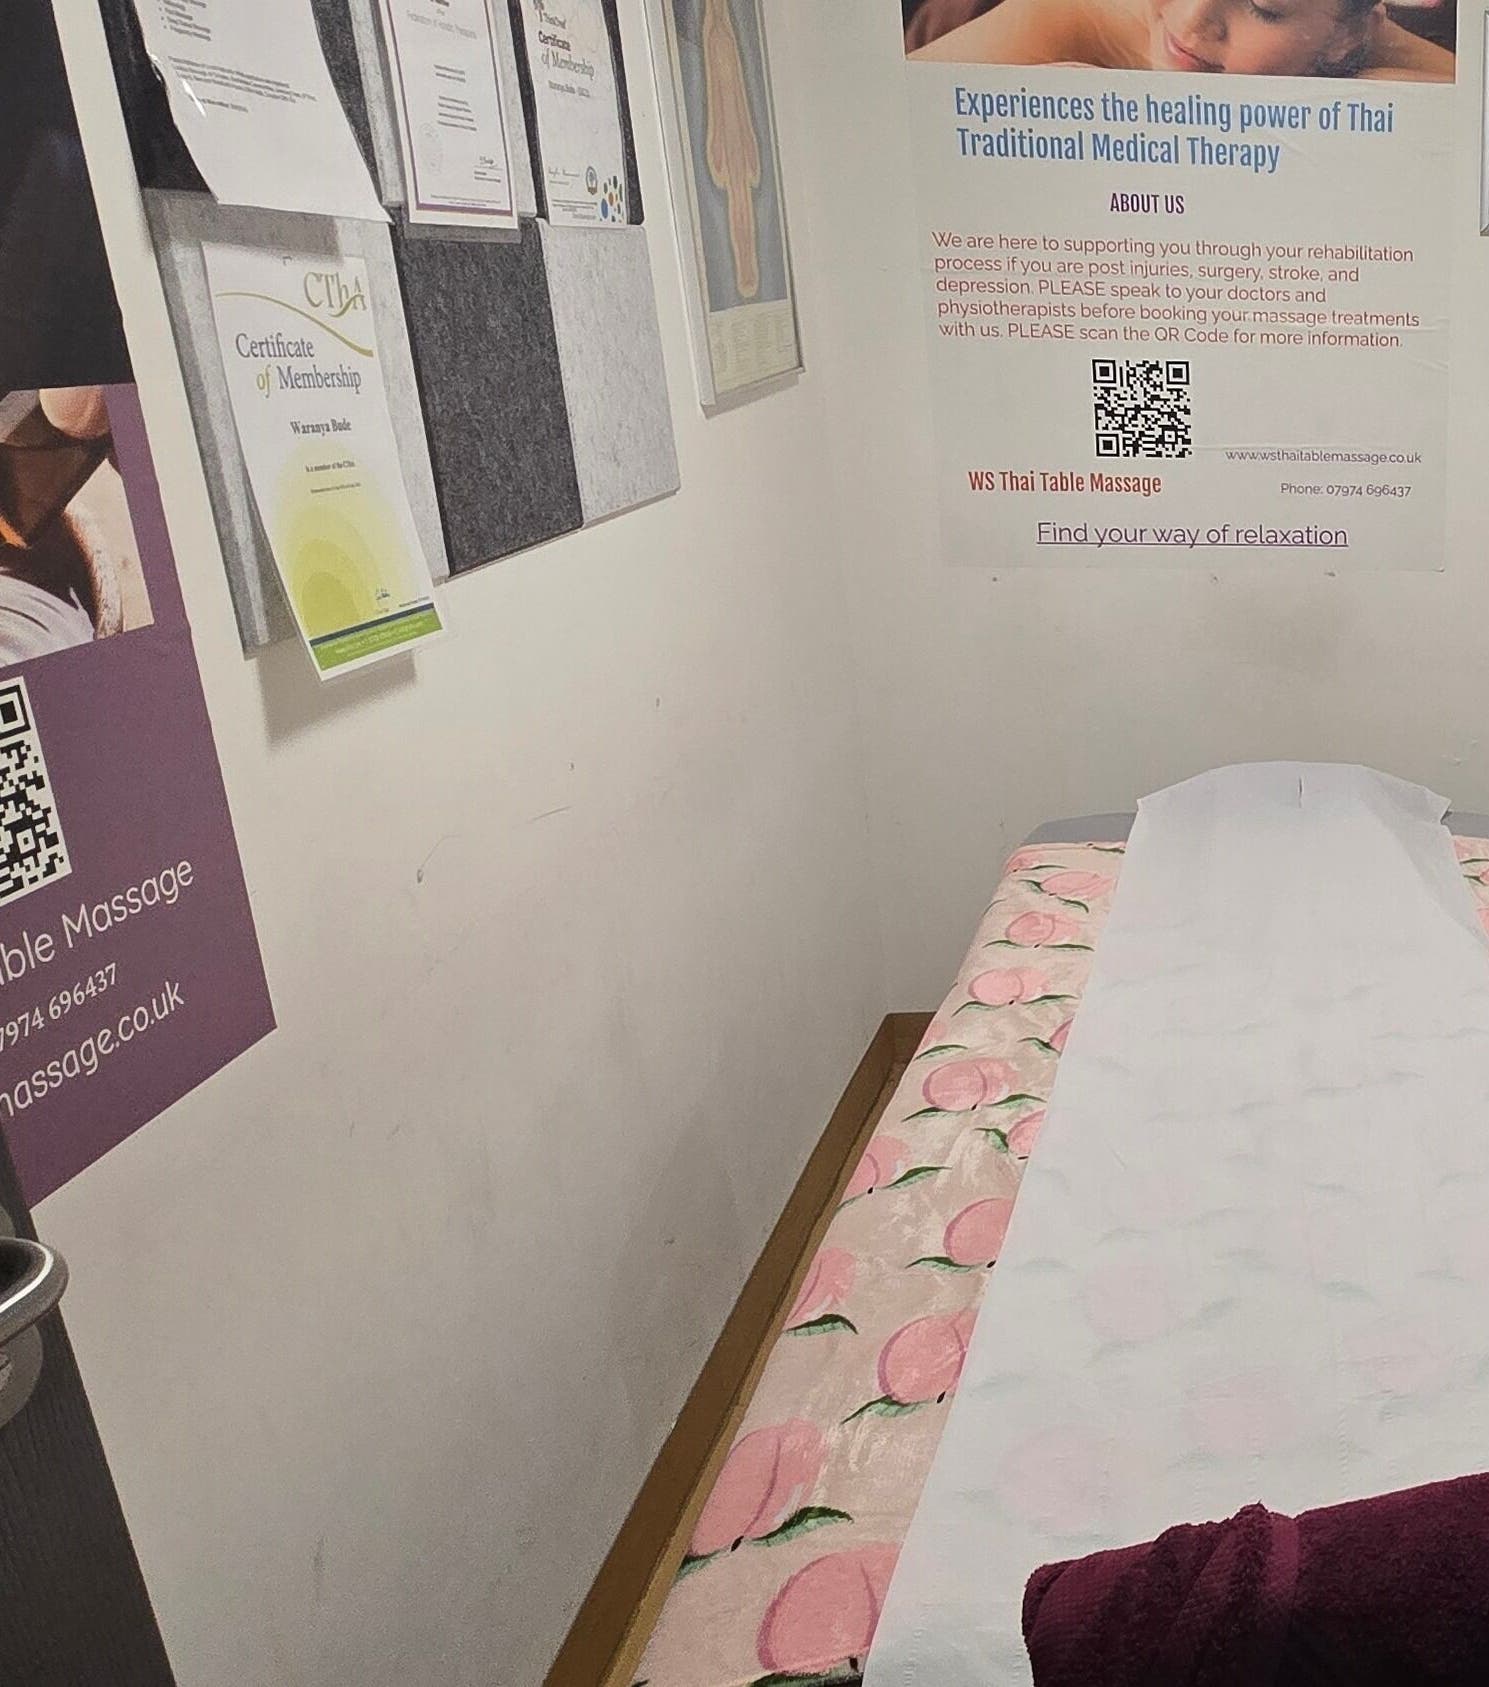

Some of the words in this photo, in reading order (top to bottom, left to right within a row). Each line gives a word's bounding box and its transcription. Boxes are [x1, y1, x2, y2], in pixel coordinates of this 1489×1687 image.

[955, 86, 1095, 123] Experiences
[1101, 91, 1138, 122] the
[1146, 93, 1232, 133] healing
[1240, 103, 1311, 133] power
[1318, 101, 1341, 130] of
[1347, 102, 1394, 133] Thai
[957, 127, 1084, 160] Traditional
[1092, 131, 1179, 164] Medical
[1187, 135, 1280, 173] Therapy
[1110, 192, 1160, 213] ABOUT
[1164, 194, 1185, 215] US
[932, 231, 962, 248] We
[966, 235, 994, 249] are
[999, 233, 1038, 250] here
[1043, 235, 1060, 251] to
[1064, 237, 1155, 257] supporting
[1159, 241, 1191, 258] you
[1196, 240, 1261, 260] through
[1266, 246, 1303, 261] your
[1307, 244, 1414, 263] rehabilitation
[935, 257, 1002, 273] process
[1007, 256, 1017, 271] if
[1020, 258, 1051, 276] you
[1057, 261, 1084, 274] are
[1088, 260, 1125, 277] post
[1130, 261, 1193, 278] injuries,
[1198, 264, 1264, 282] surgery,
[1268, 266, 1323, 282] stroke,
[1328, 267, 1360, 282] and
[303, 271, 367, 314] CThA
[936, 277, 1034, 296] depression.
[1039, 279, 1105, 297] PLEASE
[1110, 282, 1160, 300] speak
[1165, 284, 1182, 299] to
[1186, 286, 1223, 303] your
[1227, 285, 1291, 302] doctors
[1295, 288, 1327, 303] and
[938, 299, 1076, 319] physiotherapists
[1081, 302, 1135, 320] before
[1140, 304, 1207, 324] booking
[1211, 309, 1248, 324] your
[1253, 310, 1328, 327] massage
[1332, 310, 1420, 327] treatments
[235, 332, 316, 358] Certificate
[939, 322, 975, 337] with
[980, 325, 1003, 338] us.
[1008, 322, 1075, 339] PLEASE
[1079, 327, 1118, 340] scan
[1123, 325, 1150, 341] the
[1154, 327, 1179, 343] QR
[1184, 327, 1229, 344] Code
[1233, 328, 1255, 344] for
[1260, 331, 1304, 345] more
[1308, 330, 1403, 348] information.
[256, 364, 272, 398] of
[276, 363, 362, 395] Membership
[289, 420, 330, 437] Waranya
[330, 417, 352, 432] Bude
[968, 471, 995, 491] WS
[999, 470, 1035, 492] Thai
[1040, 471, 1085, 493] Table
[1090, 472, 1162, 497] Massage
[1280, 482, 1324, 495] Phone:
[1326, 484, 1362, 497] 07974
[1366, 483, 1411, 498] 696437
[1037, 522, 1088, 543] Find
[1094, 527, 1147, 548] your
[1153, 527, 1200, 548] way
[1206, 524, 1231, 544] of
[1235, 524, 1348, 546] relaxation
[0, 930, 55, 986] ble
[61, 860, 195, 949] Massage
[49, 962, 117, 1020] 696437
